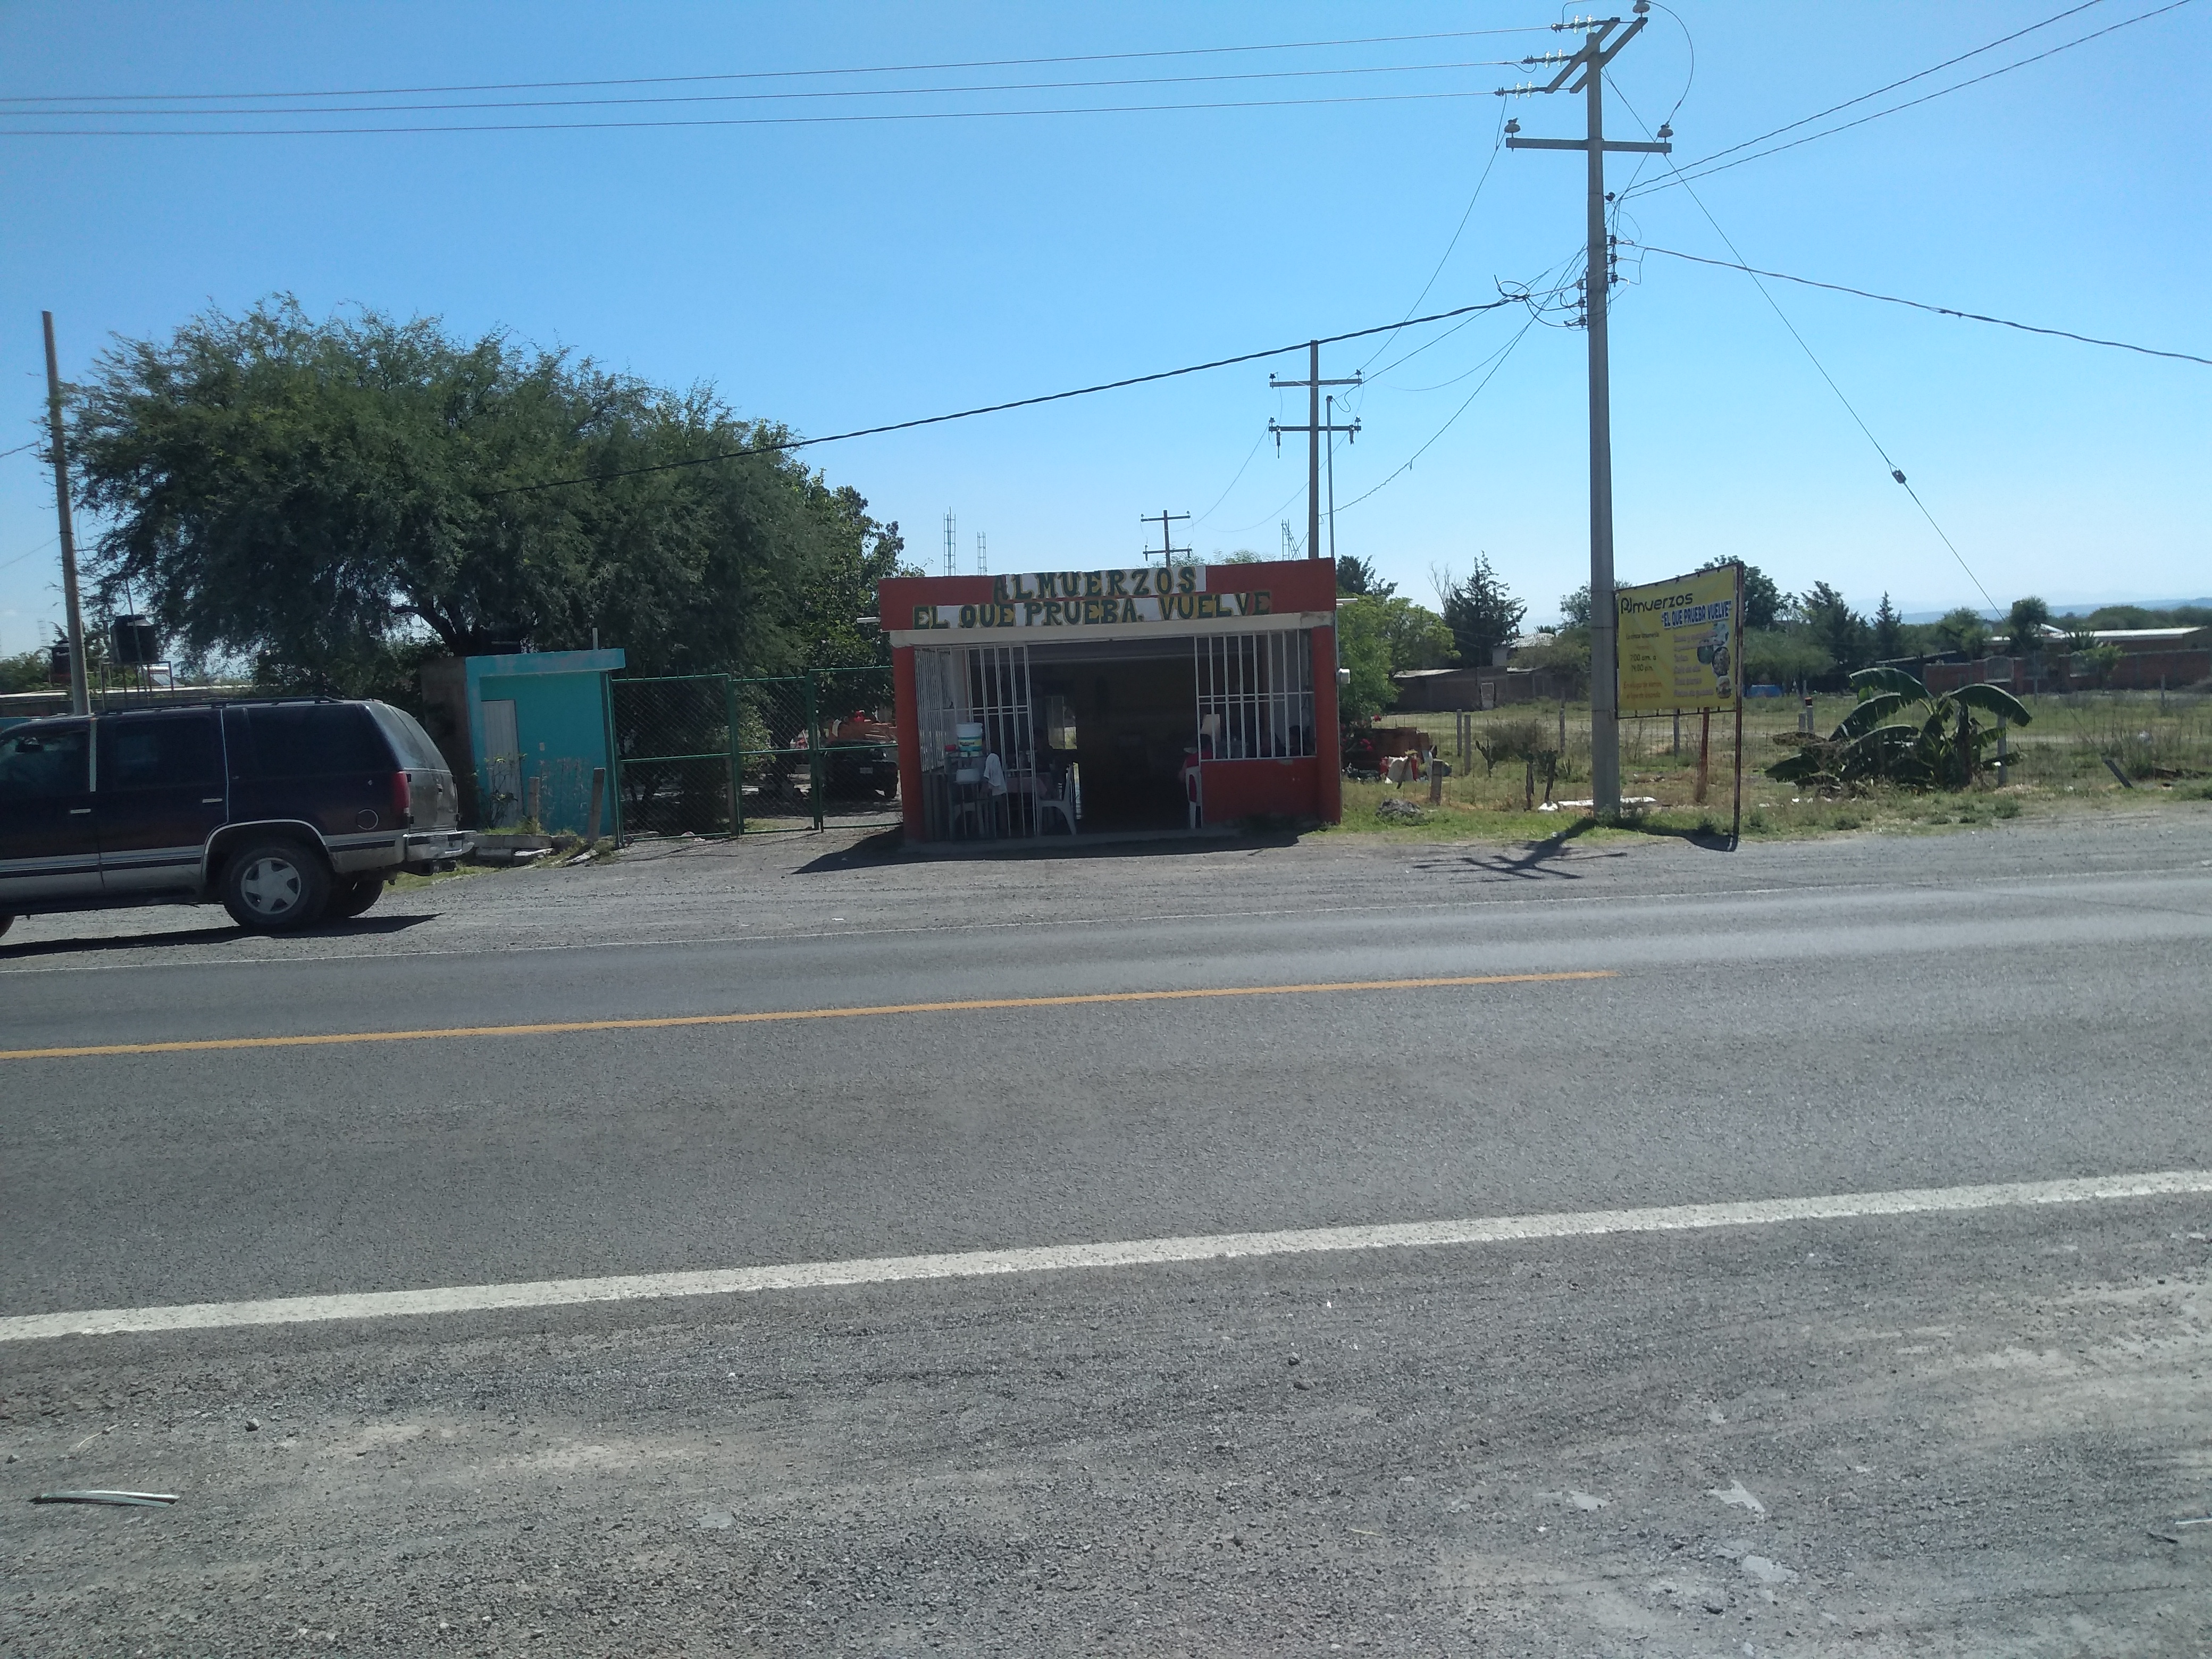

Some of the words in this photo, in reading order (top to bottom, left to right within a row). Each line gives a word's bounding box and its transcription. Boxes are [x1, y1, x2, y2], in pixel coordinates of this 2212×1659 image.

[993, 566, 1196, 604] ALMUERZOS
[914, 605, 949, 629] EL
[959, 603, 1015, 629] QUE
[1158, 591, 1271, 621] VUELVE
[1621, 593, 1693, 614] Almuerzos
[1672, 609, 1683, 626] QUE
[1684, 605, 1706, 624] PRUEBA
